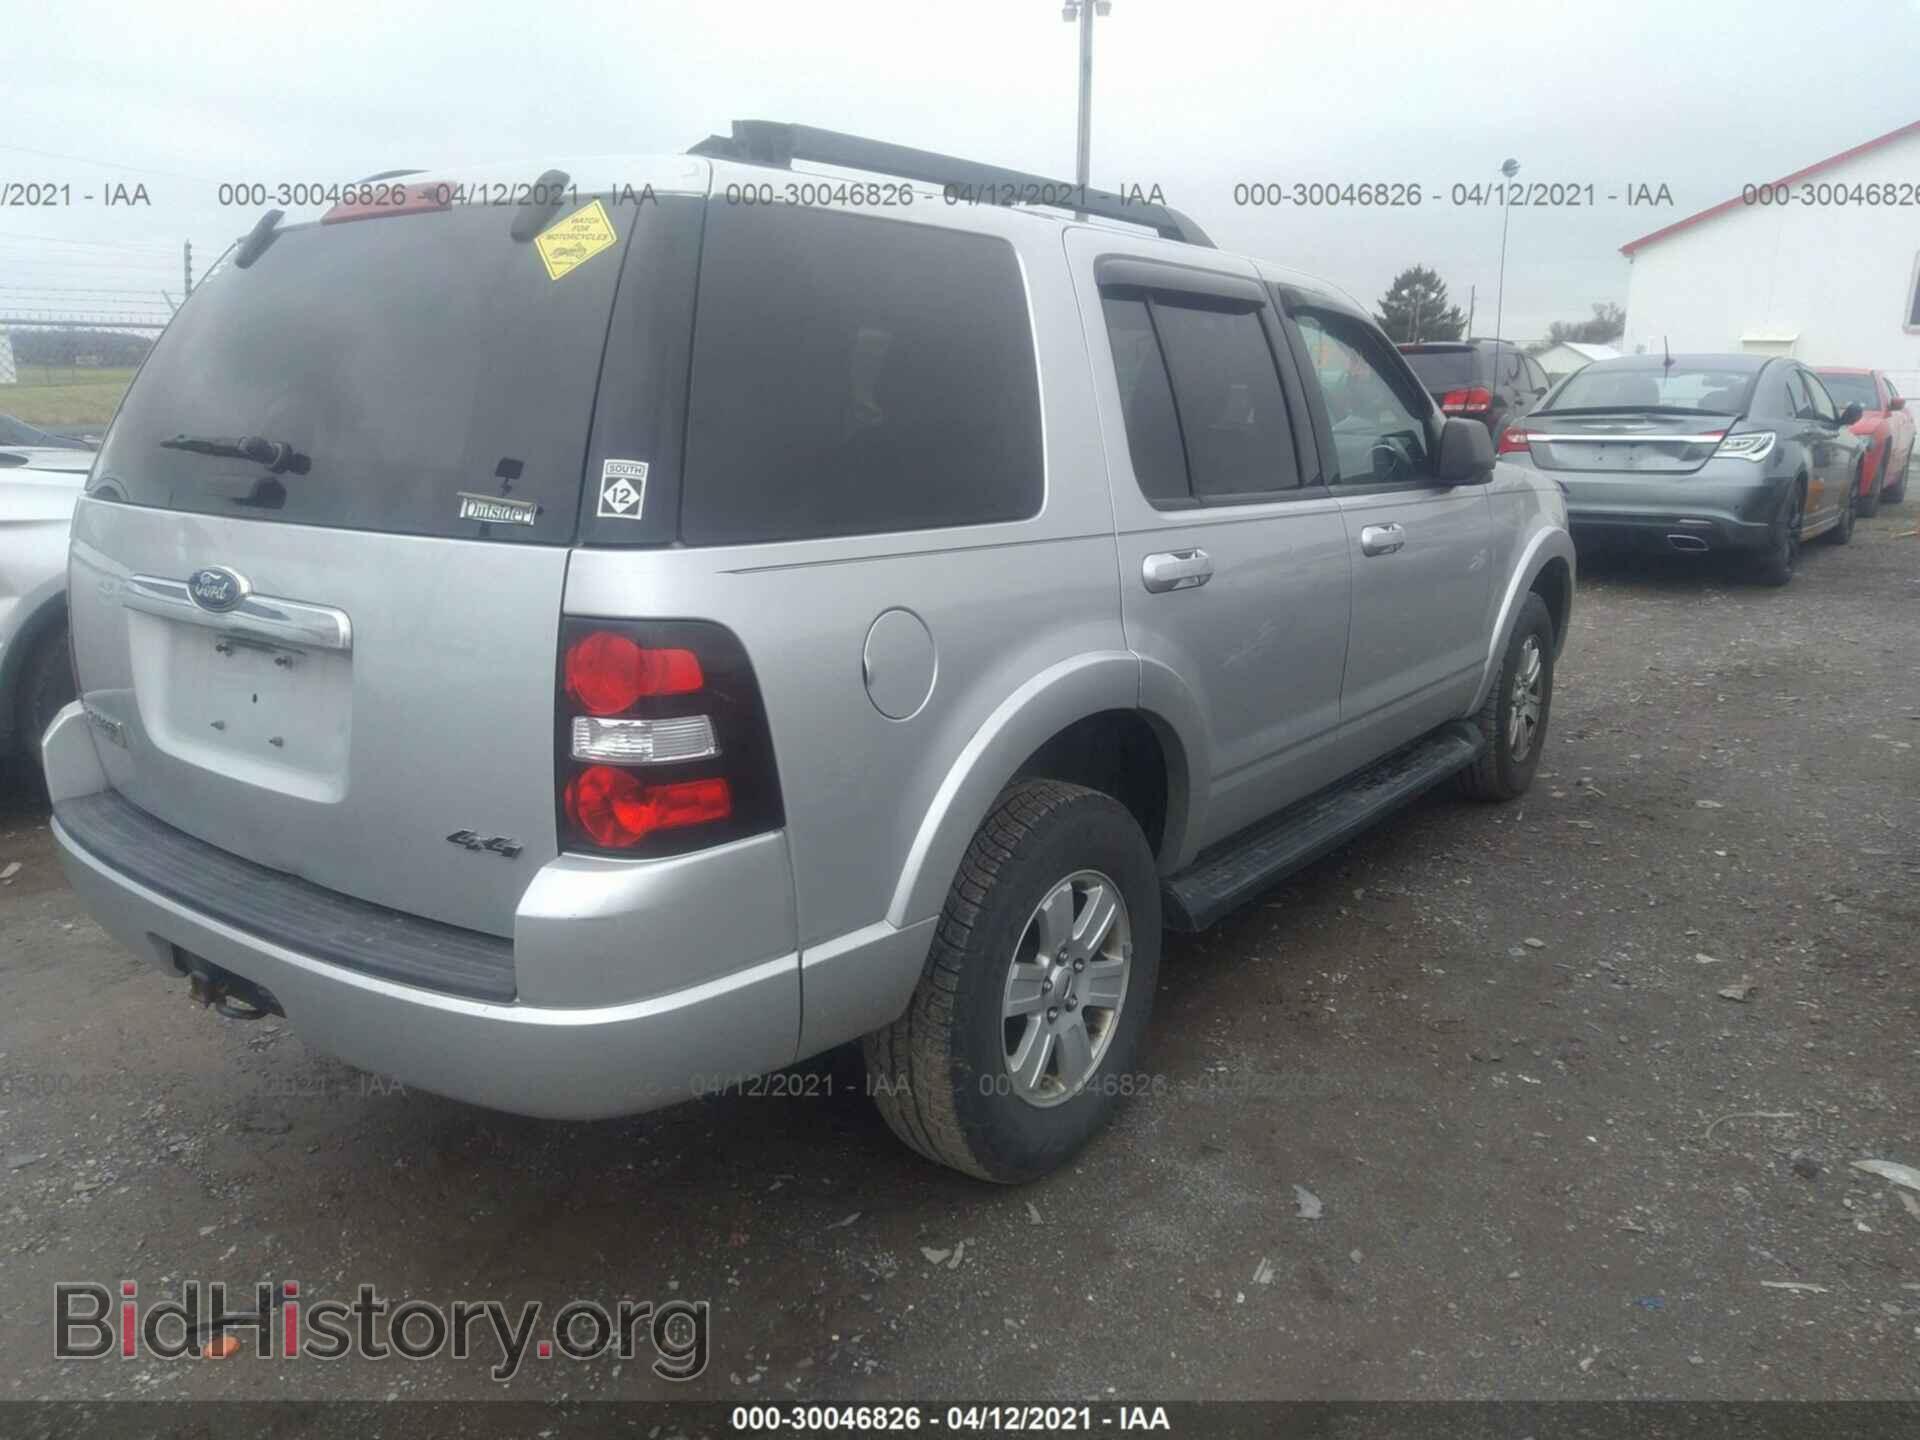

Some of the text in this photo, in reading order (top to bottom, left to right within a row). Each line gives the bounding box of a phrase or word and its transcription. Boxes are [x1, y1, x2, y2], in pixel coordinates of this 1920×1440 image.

[607, 464, 643, 475] SOUTH
[612, 488, 631, 504] 12
[194, 571, 229, 601] Ford
